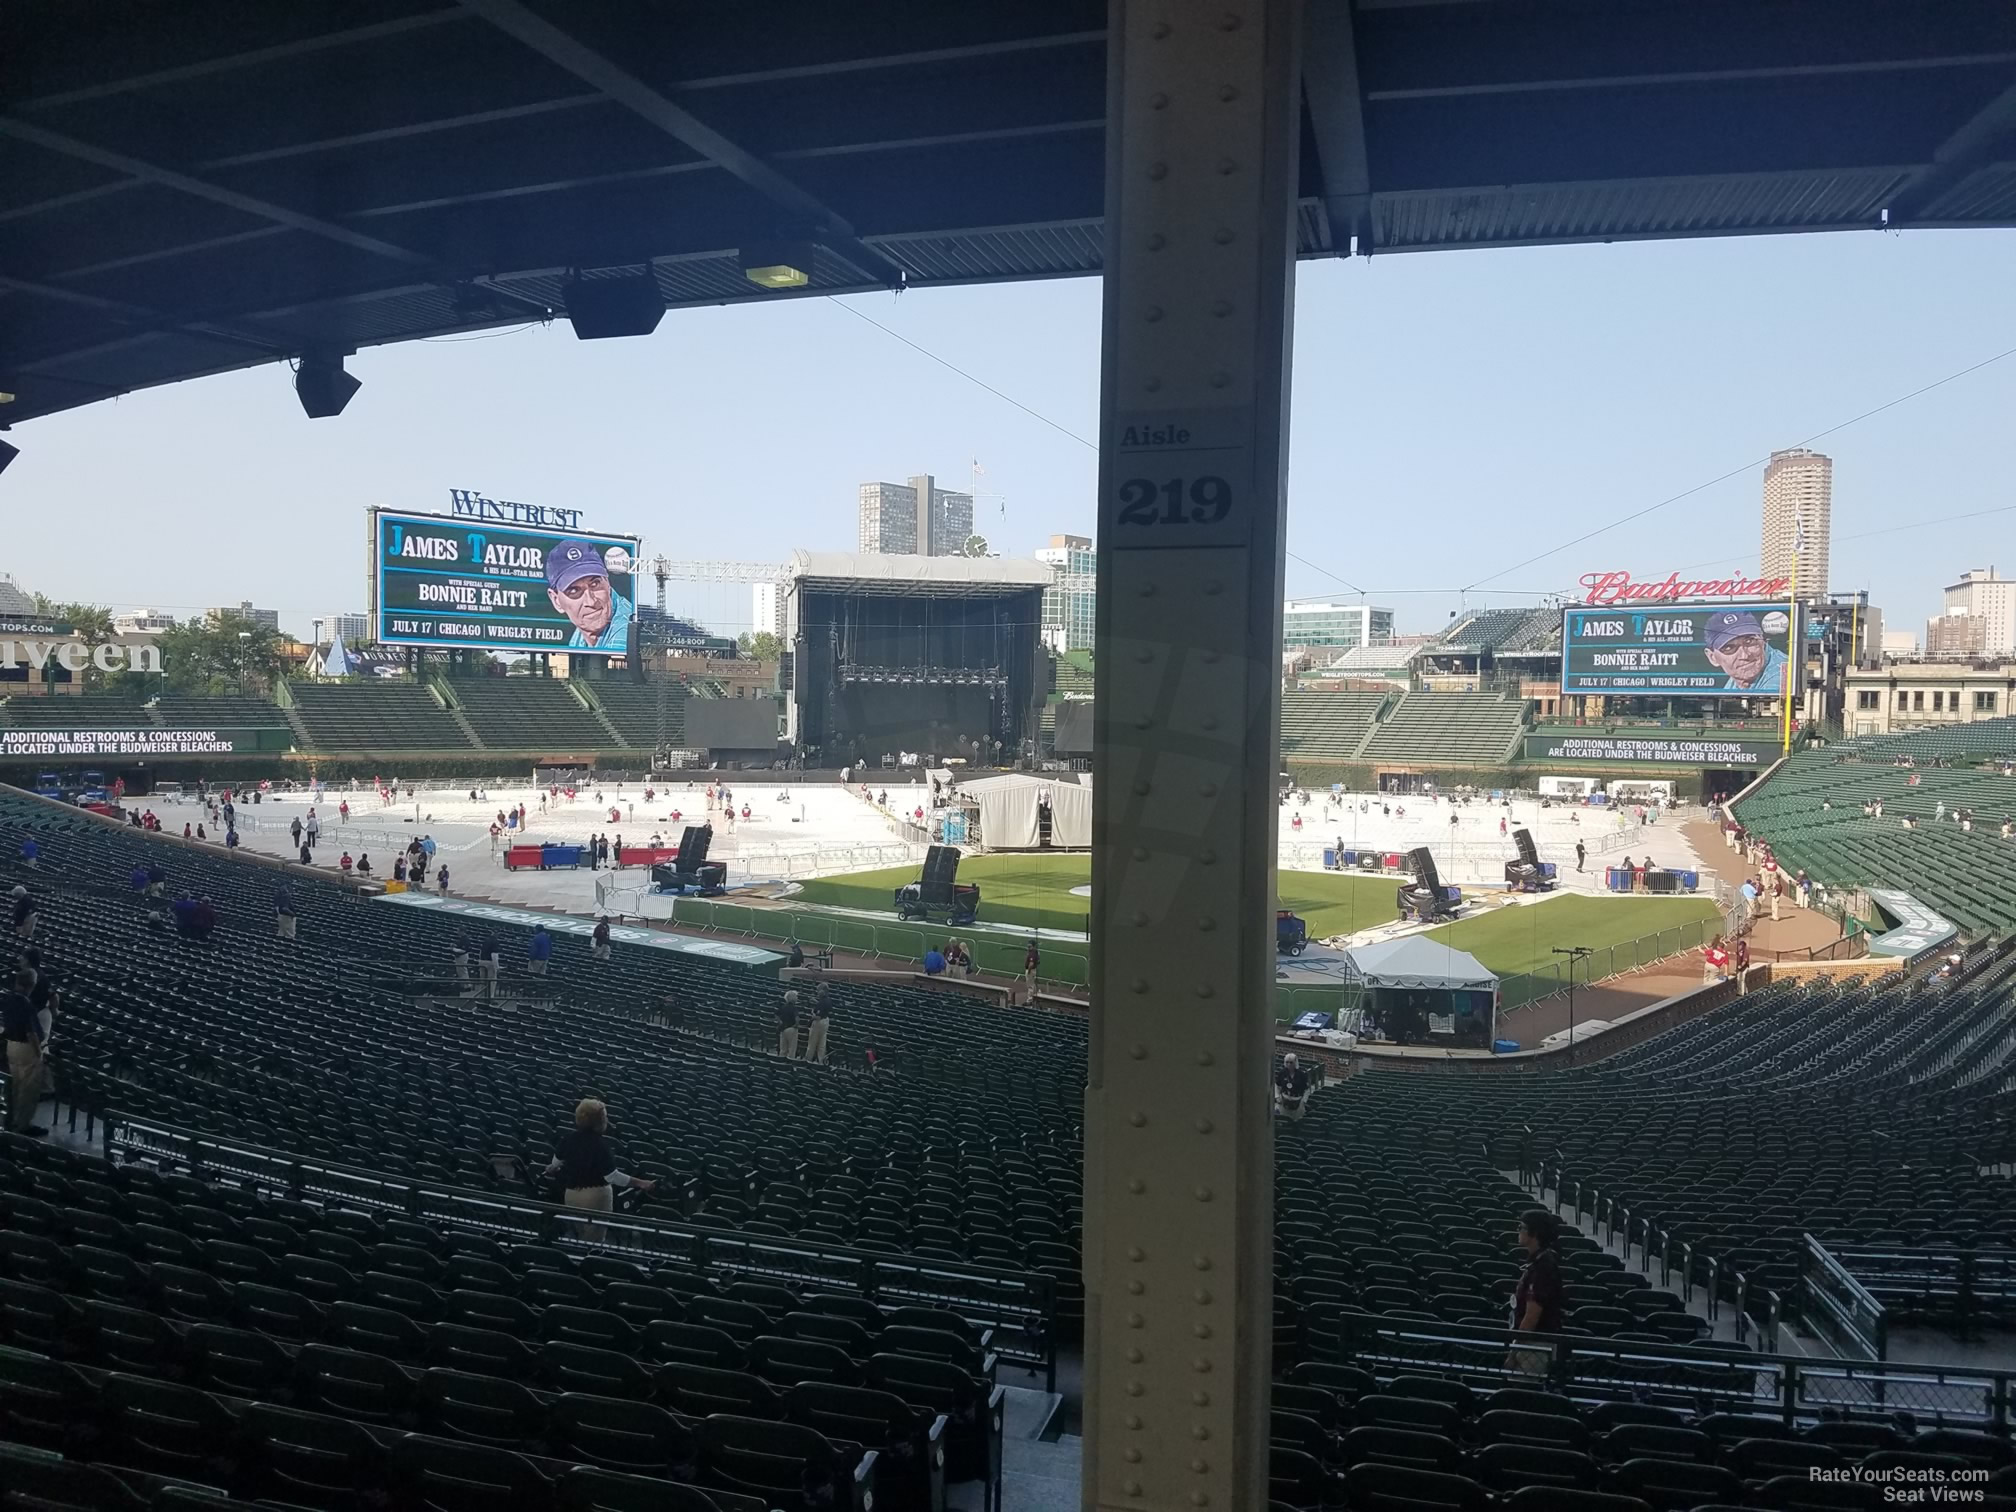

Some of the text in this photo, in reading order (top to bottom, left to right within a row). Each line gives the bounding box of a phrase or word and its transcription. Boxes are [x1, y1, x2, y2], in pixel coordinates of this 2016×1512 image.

[1120, 424, 1191, 446] Aisle
[450, 488, 583, 529] WINTRUST
[1117, 475, 1233, 526] 219
[389, 525, 544, 569] JAMES TAYLOR
[529, 570, 544, 578] BAND
[418, 583, 528, 608] BONNIE RAITT
[1579, 570, 1791, 604] Budweiser
[392, 620, 563, 641] JULY 17 CHICAGO WRIGLEY FIELD
[1573, 615, 1694, 637] JAMES TAYLOR
[1593, 653, 1679, 666] BONNIE RAITT
[1579, 677, 1715, 686] JULY 17 CHICAGO WRIGLEY FIELD
[2, 731, 216, 743] ADDITIONAL RESTROOMS & CONCESSIONS
[7, 743, 56, 754] LOCATED
[58, 743, 95, 753] UNDER
[98, 742, 117, 753] THE
[120, 742, 178, 753] BUDWEISER
[180, 741, 233, 752] BLEACHERS
[1563, 739, 1741, 752] ADDITIONAL RESTROOMS & CONCESSIONS
[1548, 748, 1757, 763] ARE LOCATED UNDER THE BUDWEISER BLEACHERS
[464, 907, 650, 939] CHICAGO CBS
